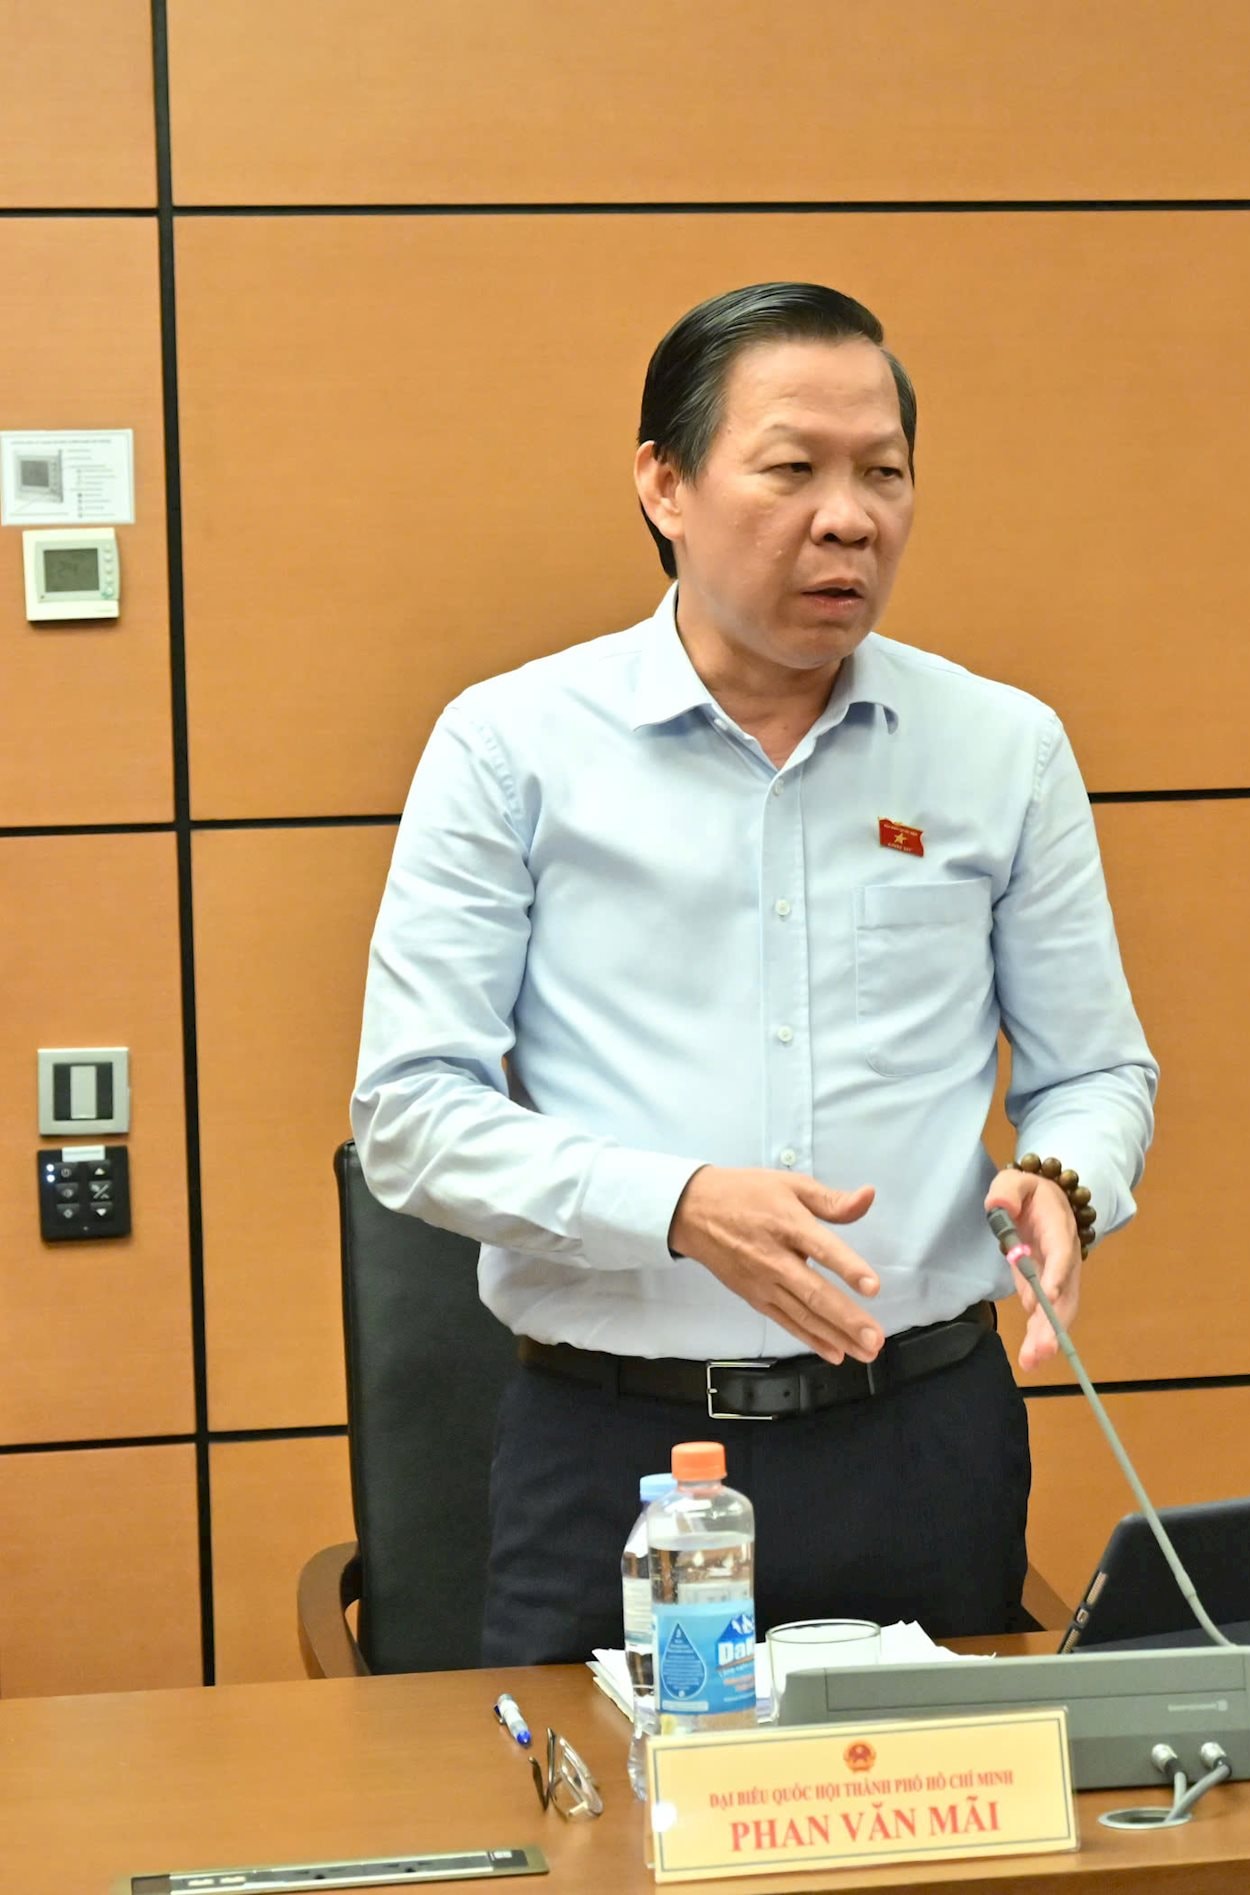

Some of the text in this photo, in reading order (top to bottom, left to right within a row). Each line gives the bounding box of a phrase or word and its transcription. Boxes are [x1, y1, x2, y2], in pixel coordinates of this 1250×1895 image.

[709, 1792, 733, 1811] ĐẠI
[772, 1783, 811, 1806] QUỐC
[815, 1783, 840, 1802] HỘI
[844, 1778, 891, 1798] THÀNH
[894, 1774, 923, 1793] PHỐ
[926, 1772, 946, 1791] HỒ
[949, 1770, 974, 1789] CHÍ
[977, 1770, 1013, 1786] MINH
[730, 1796, 1000, 1851] PHAN VĂN MÃI
